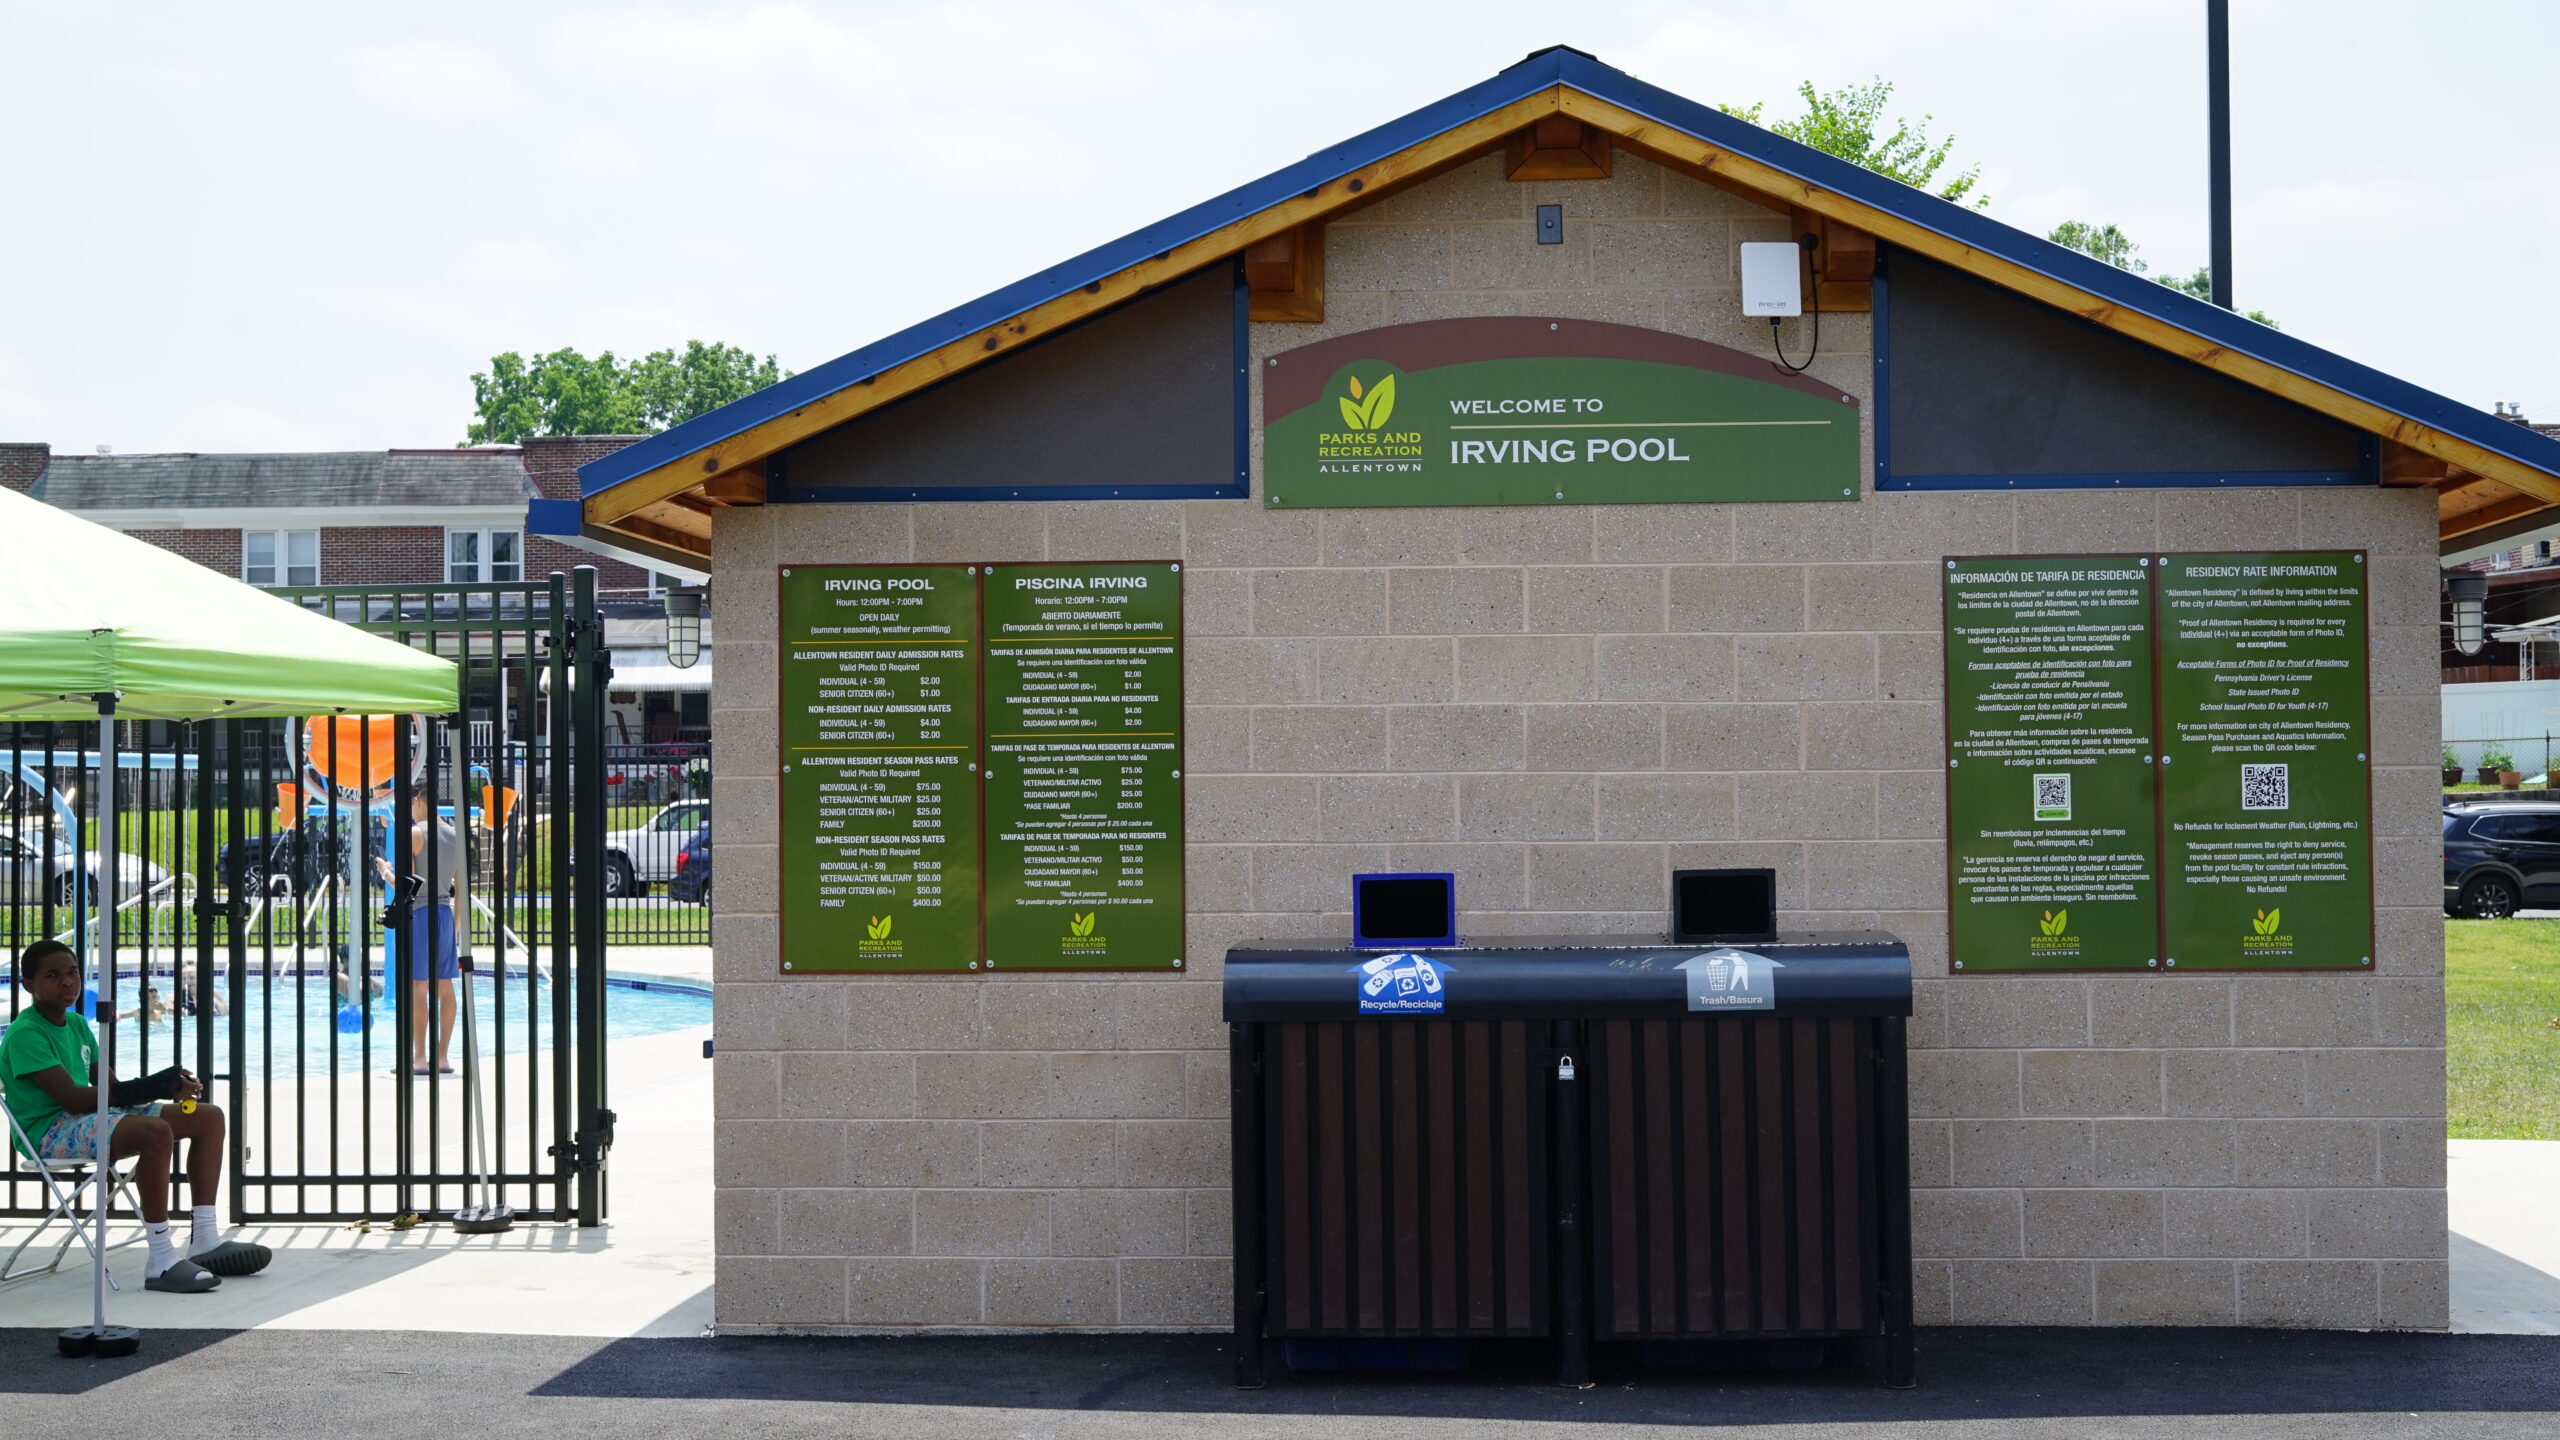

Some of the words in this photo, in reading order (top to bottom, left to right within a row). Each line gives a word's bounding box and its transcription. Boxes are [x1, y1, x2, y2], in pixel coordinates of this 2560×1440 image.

[1450, 399, 1566, 414] WELCOME
[1572, 399, 1603, 412] TO
[1320, 433, 1377, 444] PARKS
[1383, 433, 1421, 443] AND
[1319, 446, 1422, 456] RECREATION
[1451, 440, 1576, 464] IRVING
[1587, 438, 1690, 462] POOL
[1320, 464, 1421, 472] ALLENTOWN
[2186, 567, 2241, 577] RESIDENCY
[2243, 566, 2268, 576] RATE
[2270, 566, 2337, 576] INFORMATION
[1950, 571, 2018, 584] INFORMACIÓN
[2021, 572, 2034, 582] DE
[2036, 571, 2070, 581] TARIFA
[2072, 571, 2085, 581] DE
[2087, 570, 2145, 581] RESIDENCIA
[825, 579, 882, 591] IRVING
[888, 579, 935, 590] POOL
[1016, 578, 1084, 589] PISCINA
[1090, 577, 1147, 588] IRVING
[2056, 589, 2077, 597] define
[2249, 588, 2274, 596] defined
[2276, 589, 2284, 597] by
[2286, 588, 2303, 596] living
[860, 598, 890, 606] 12:00PM
[897, 598, 923, 606] 7:00PM
[1035, 597, 1063, 605] Horario:
[1064, 596, 1094, 604] 12:00PM
[1101, 596, 1128, 604] 7:00PM
[1042, 612, 1072, 620] ABIERTO
[1073, 611, 1121, 619] DIARIAMENTE
[2015, 610, 2036, 619] postal
[811, 626, 842, 635] (summer
[843, 626, 881, 635] seasonally,
[882, 625, 911, 633] weather
[913, 625, 951, 634] permitting)
[1003, 623, 1044, 632] (Temporada
[1045, 623, 1054, 631] de
[1099, 622, 1124, 631] tiempo
[1133, 622, 1163, 631] permite)
[839, 651, 874, 659] RESIDENT
[876, 651, 896, 659] DAILY
[858, 663, 878, 671] Photo
[880, 663, 887, 671] ID
[889, 663, 920, 672] Required
[820, 678, 858, 686] INDIVIDUAL
[860, 678, 867, 686] (4
[874, 677, 885, 686] 59)
[920, 677, 941, 685] $2.00
[2214, 674, 2258, 683] Pennsylvania
[820, 690, 846, 698] SENIOR
[847, 690, 874, 698] CITIZEN
[876, 690, 895, 699] (60+)
[920, 689, 940, 697] $1.00
[808, 705, 862, 713] NON-RESIDENT
[864, 705, 884, 713] DAILY
[802, 757, 845, 765] ALLENTOWN
[847, 757, 882, 765] RESIDENT
[884, 757, 913, 765] SEASON
[935, 756, 959, 764] RATES
[820, 796, 878, 804] VETERAN/ACTIVE
[880, 795, 912, 803] MILITARY
[917, 795, 941, 803] $25.00
[912, 819, 941, 828] $200.00
[2174, 823, 2184, 831] No
[2225, 822, 2258, 830] Inclement
[2288, 821, 2308, 830] (Rain,
[2308, 821, 2342, 830] Lightning,
[2343, 821, 2358, 829] etc.)
[816, 836, 869, 844] NON-RESIDENT
[902, 835, 920, 843] PASS
[922, 835, 945, 843] RATES
[2013, 839, 2035, 848] (lluvia,
[2079, 839, 2093, 847] etc.)
[2258, 885, 2287, 893] Refunds!
[821, 899, 845, 907] FAMILY
[913, 898, 942, 907] $400.00
[1699, 995, 1763, 1004] Trash/Basura
[1361, 999, 1442, 1010] Recycle/Reciclaje
